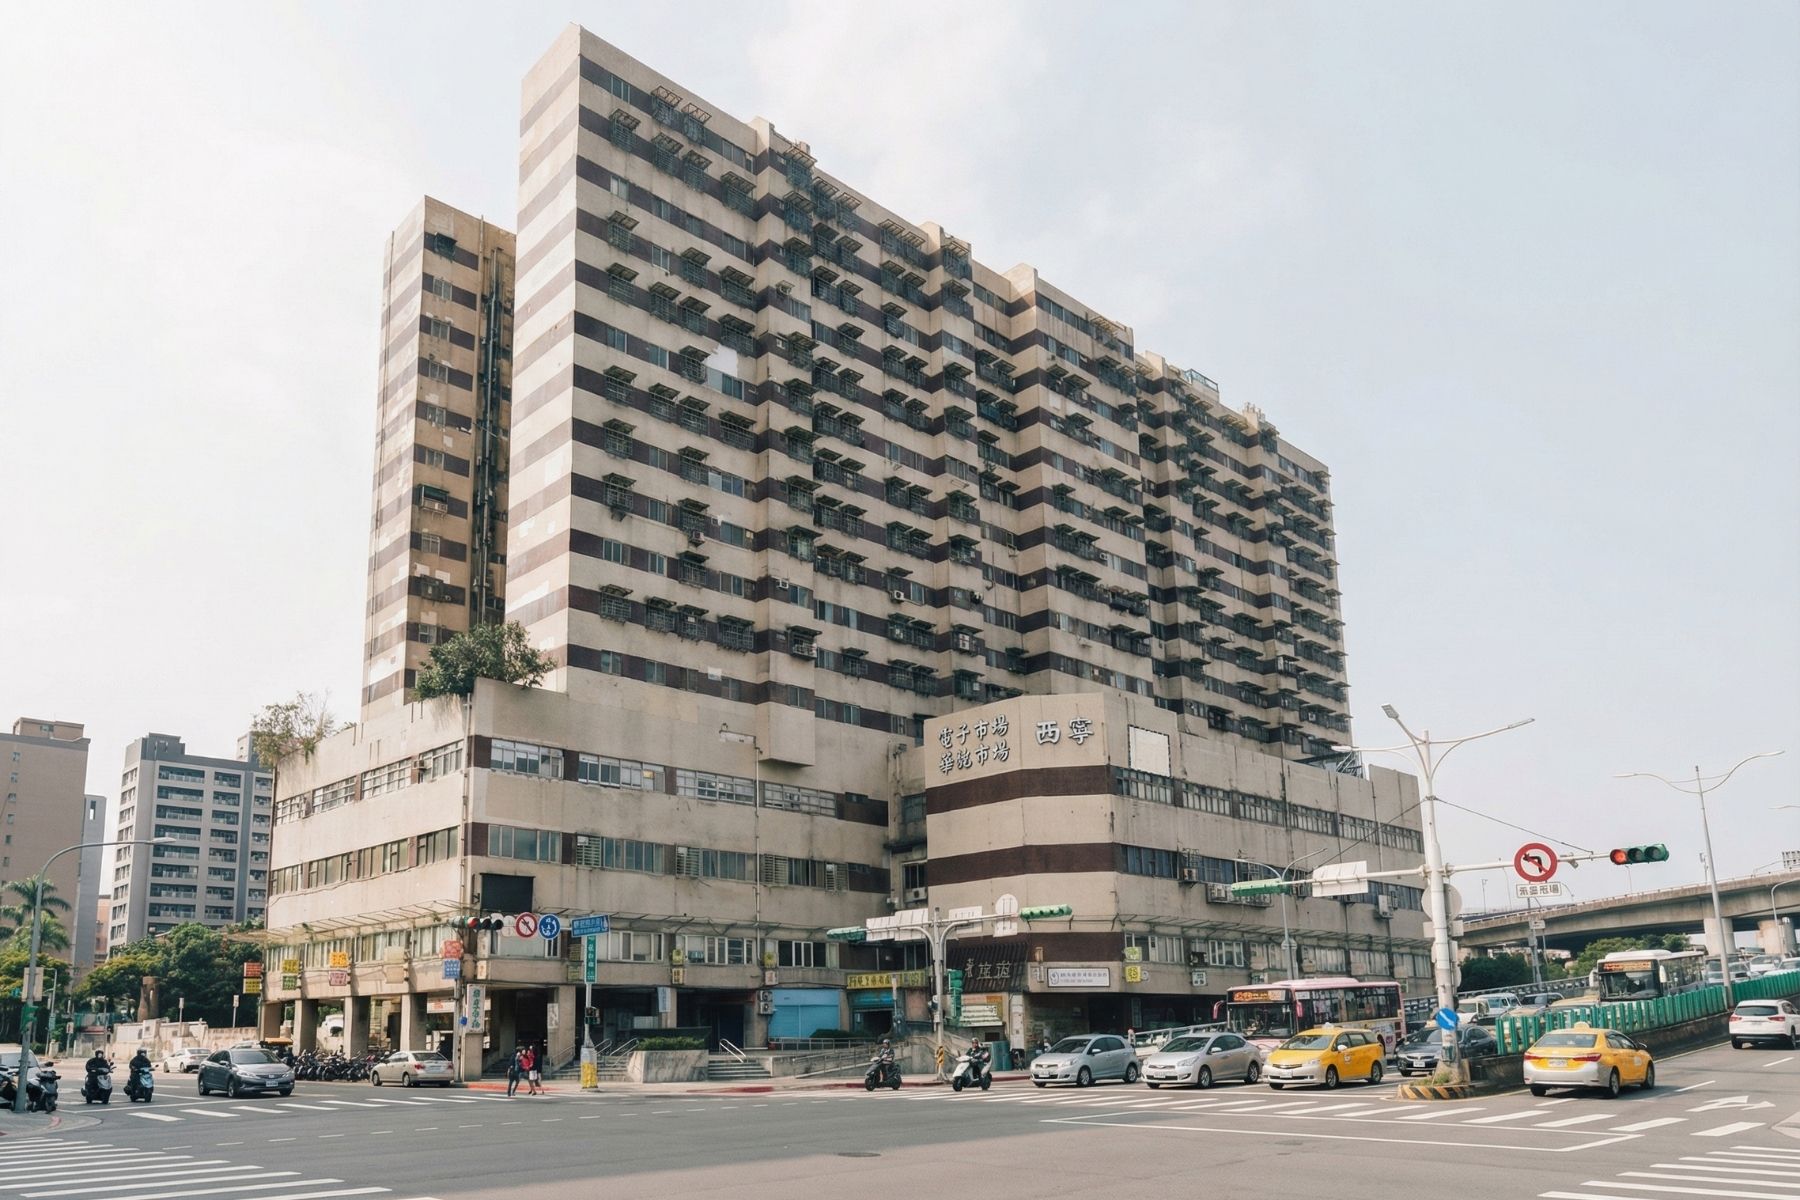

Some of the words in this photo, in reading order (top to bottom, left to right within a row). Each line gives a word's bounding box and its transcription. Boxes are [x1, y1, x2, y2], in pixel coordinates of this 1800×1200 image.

[939, 714, 1009, 749] 電子市場
[1036, 717, 1094, 745] 西寧
